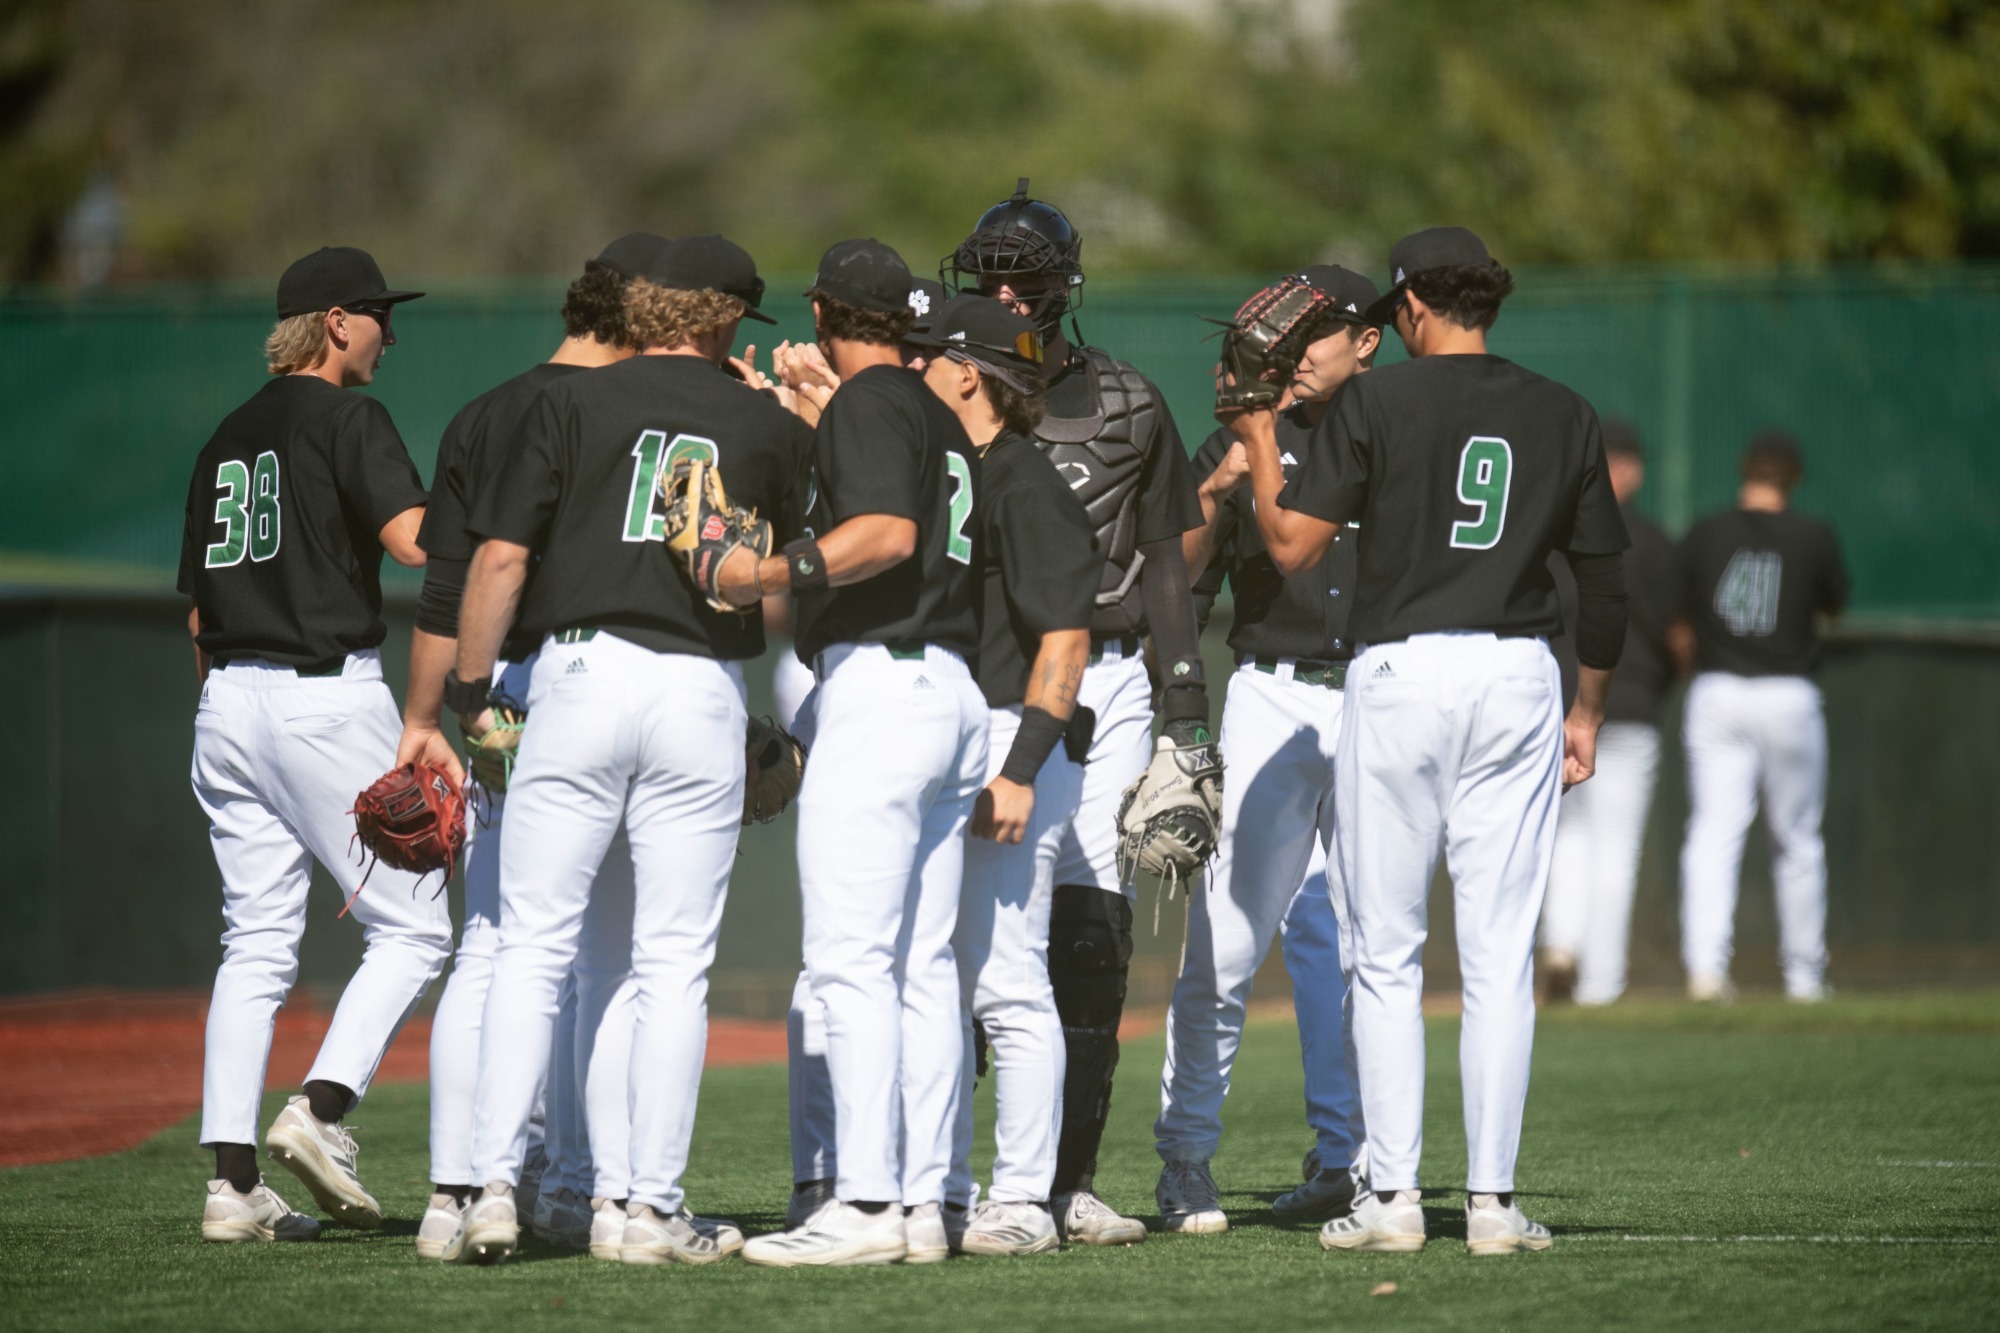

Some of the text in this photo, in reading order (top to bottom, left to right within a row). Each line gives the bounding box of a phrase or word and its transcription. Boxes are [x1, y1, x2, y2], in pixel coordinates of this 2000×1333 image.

[205, 450, 281, 569] 38
[1450, 436, 1513, 550] 9
[1713, 550, 1782, 637] 41
